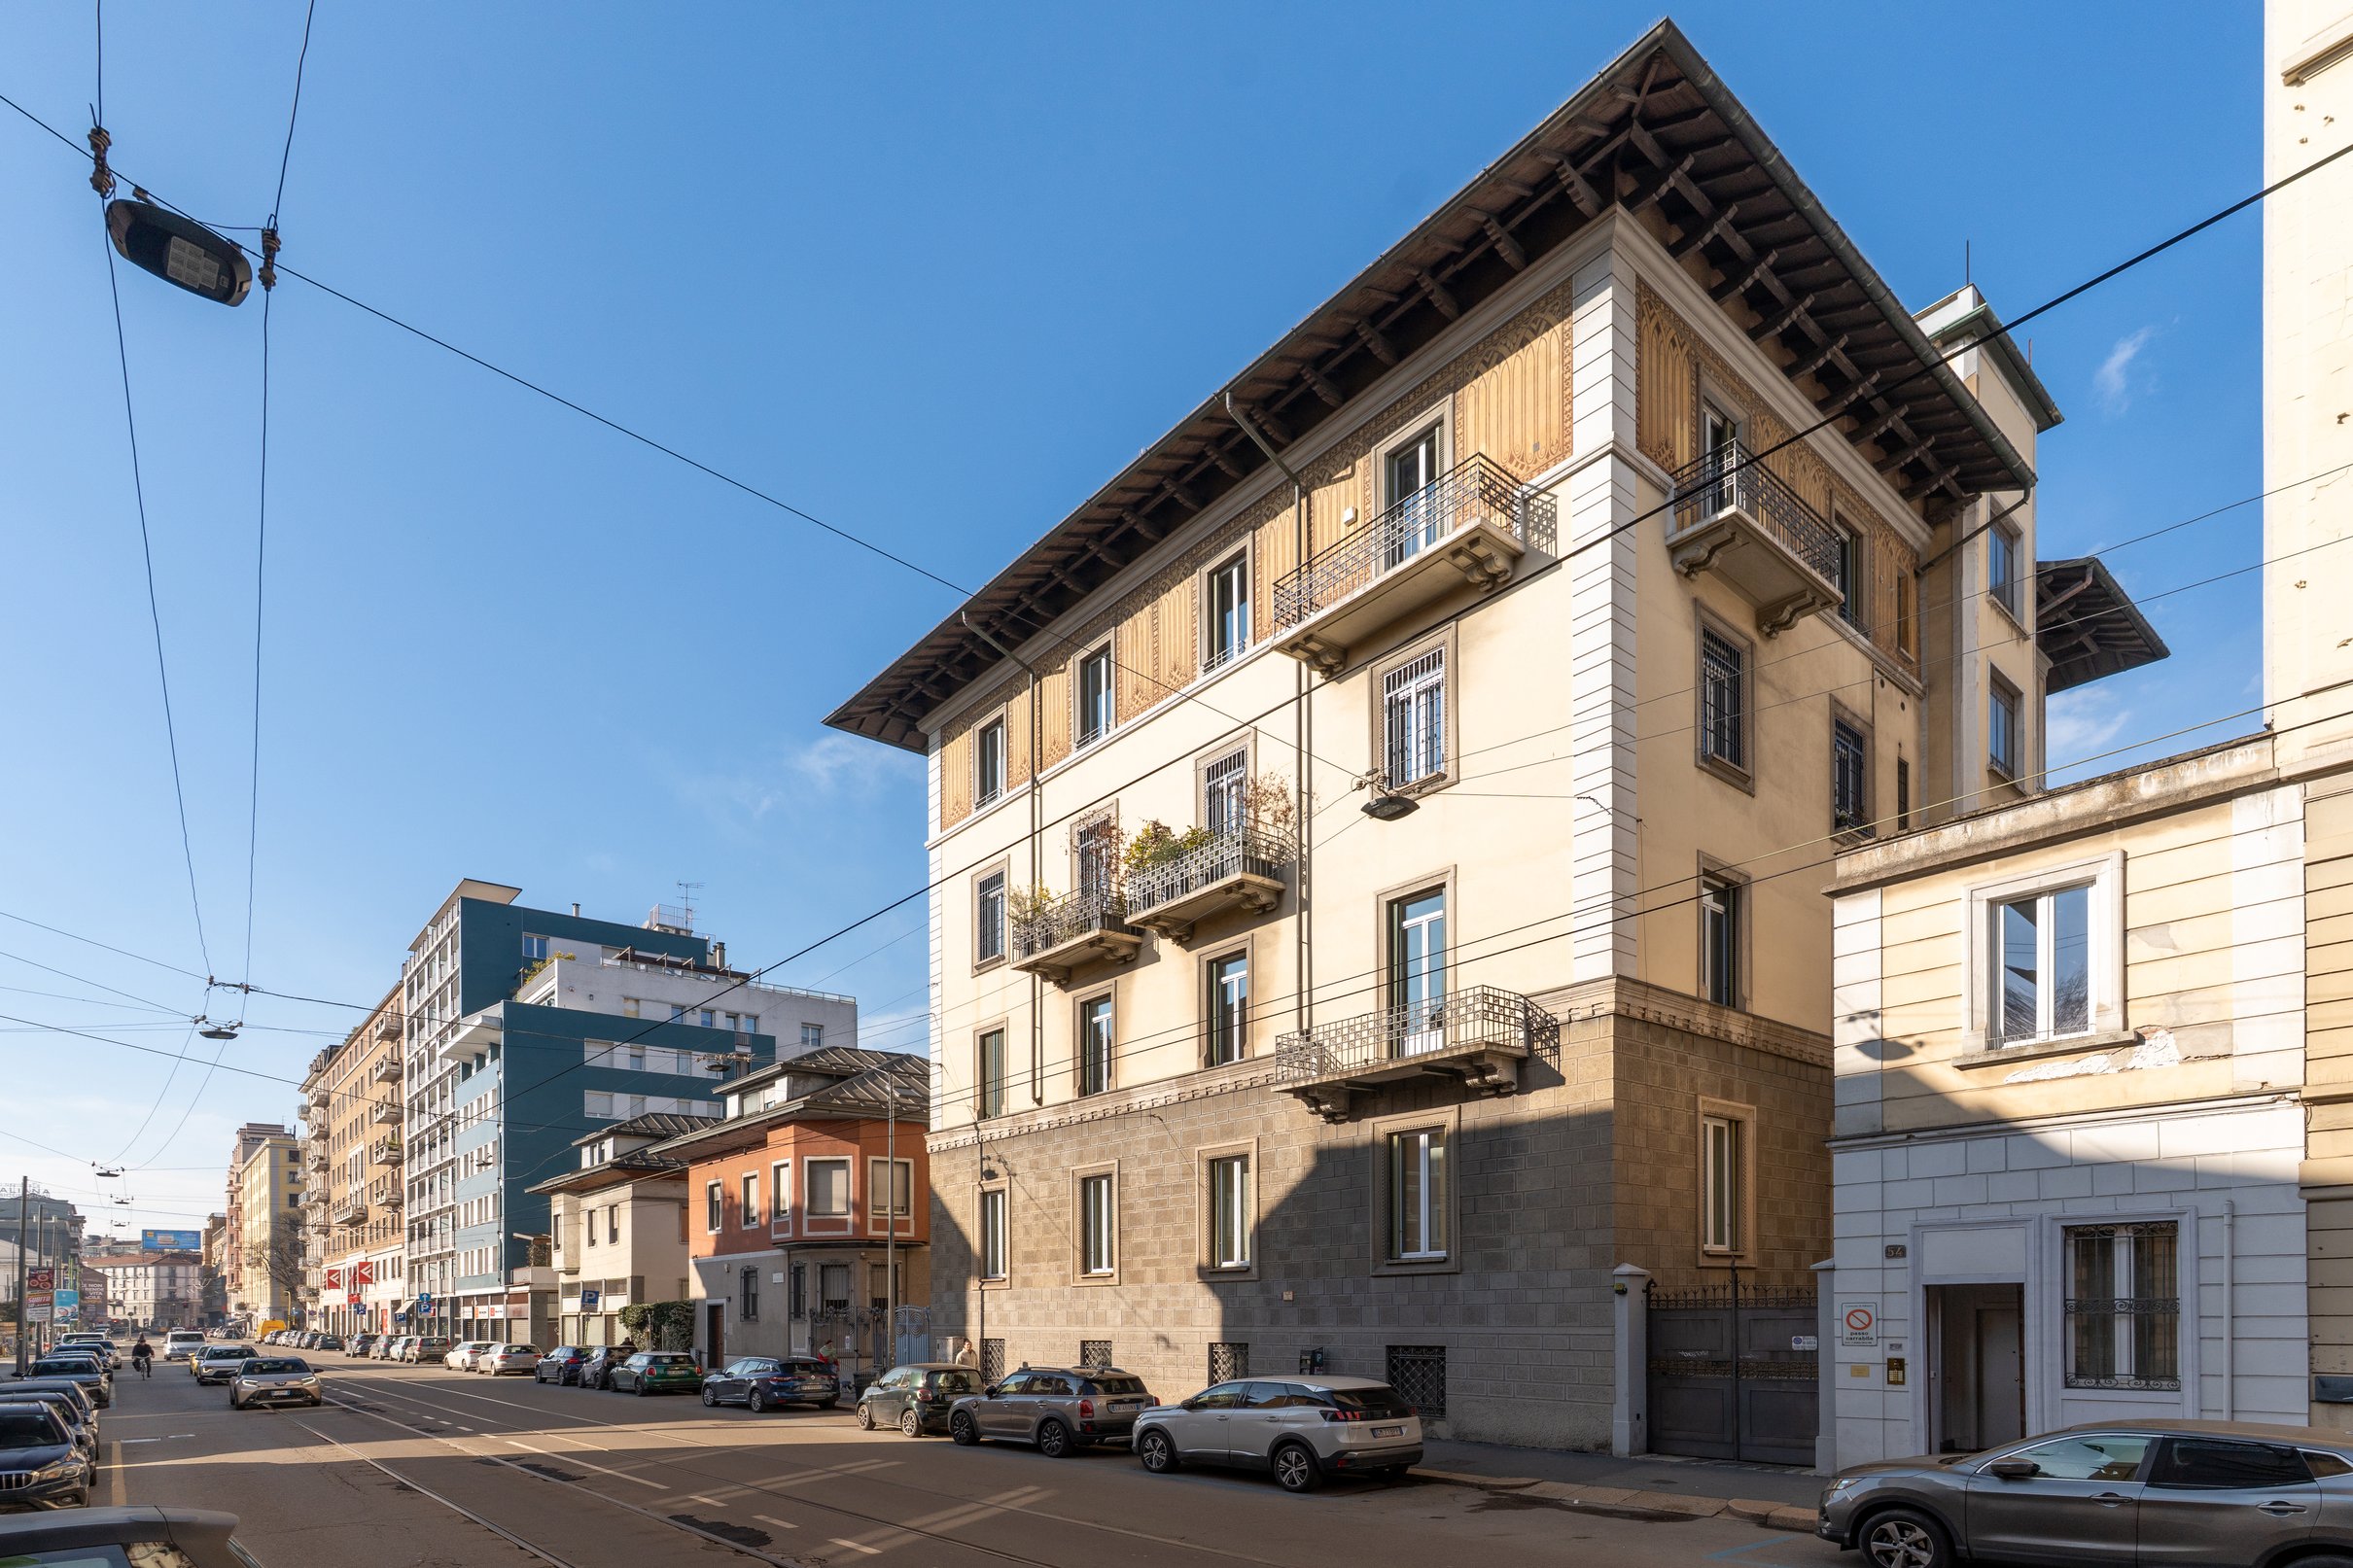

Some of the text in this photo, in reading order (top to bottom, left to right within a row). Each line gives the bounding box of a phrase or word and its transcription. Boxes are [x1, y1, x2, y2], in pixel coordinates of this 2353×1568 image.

[1887, 1246, 1904, 1257] 54
[585, 1292, 596, 1303] P
[421, 1304, 430, 1312] P
